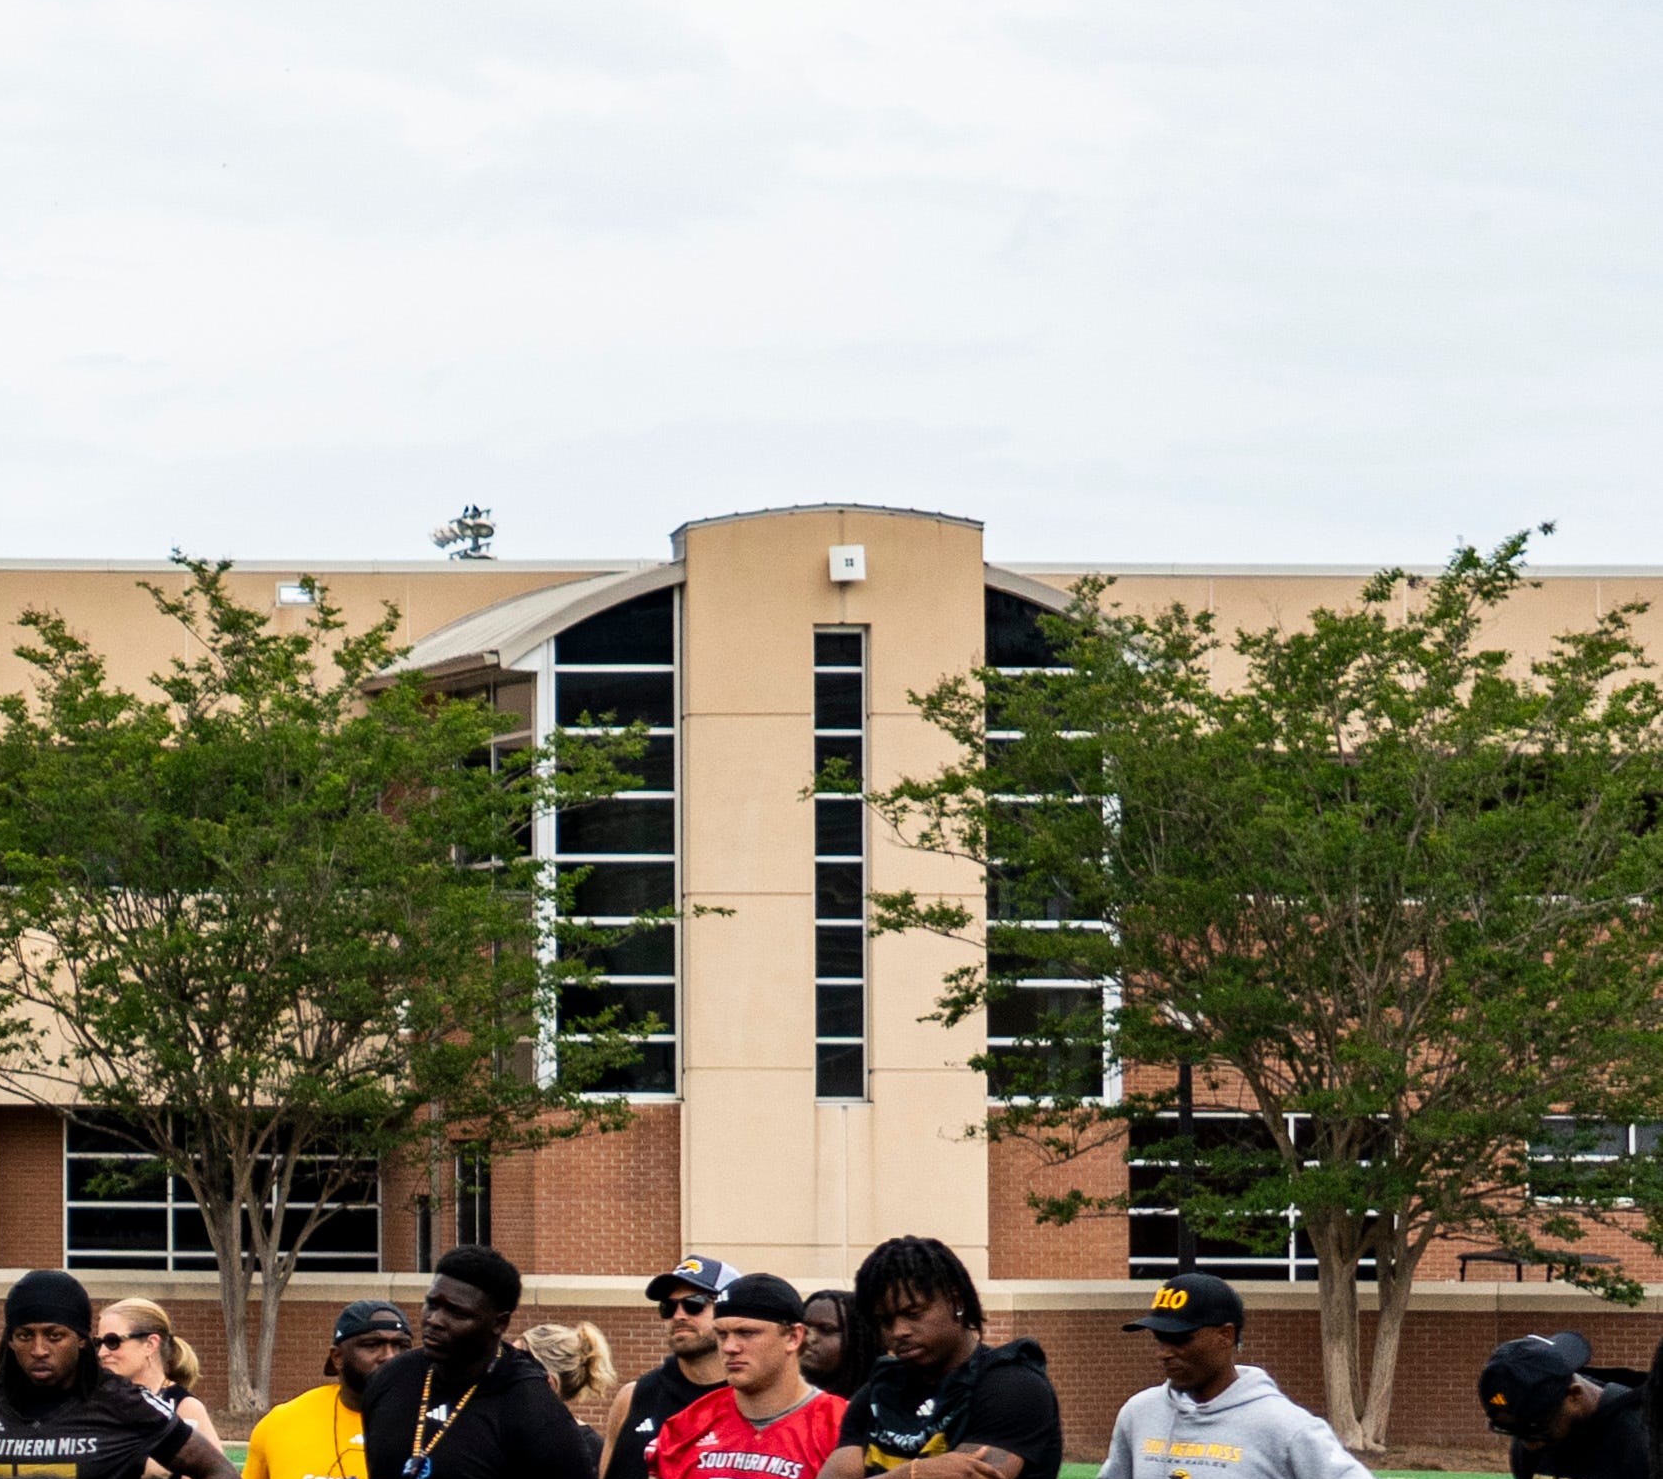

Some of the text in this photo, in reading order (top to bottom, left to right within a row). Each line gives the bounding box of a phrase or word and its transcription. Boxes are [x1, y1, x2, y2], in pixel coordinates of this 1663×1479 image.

[57, 1437, 98, 1455] MISS
[696, 1450, 804, 1479] SOUTHERN MISS
